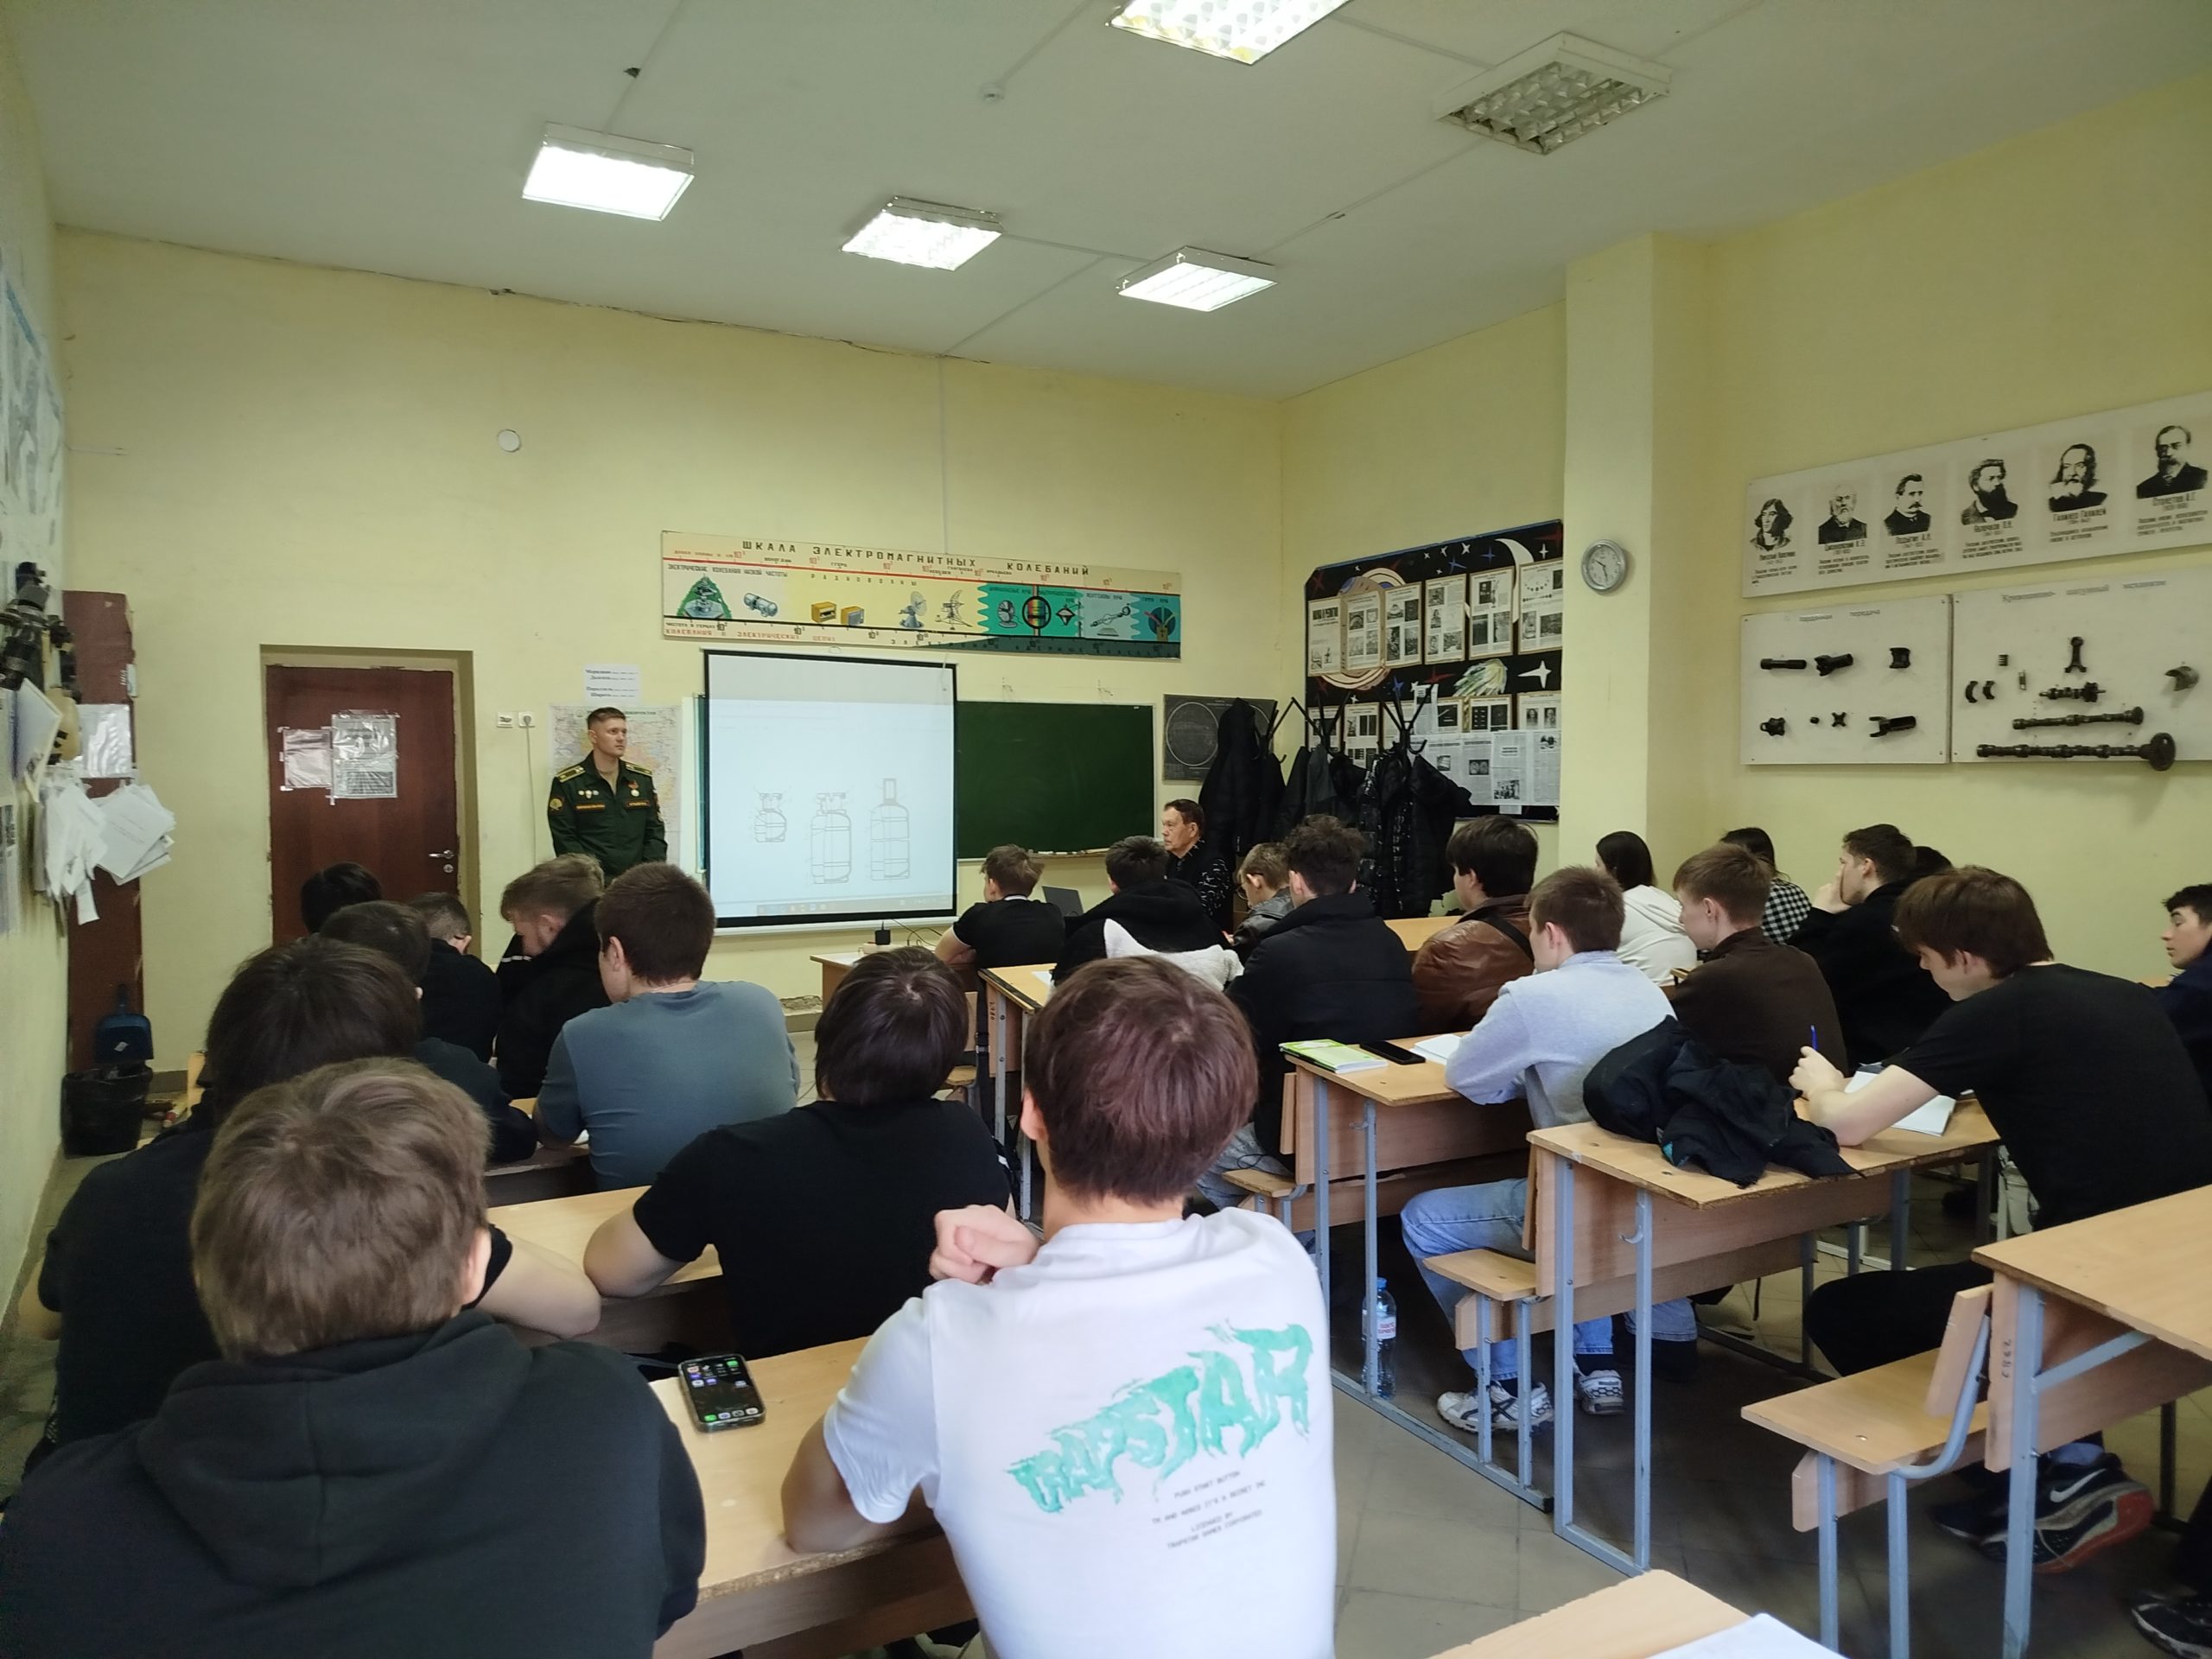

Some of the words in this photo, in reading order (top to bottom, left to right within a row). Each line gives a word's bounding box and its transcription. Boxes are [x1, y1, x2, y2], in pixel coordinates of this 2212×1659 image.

[742, 540, 796, 553] ШКАЛА
[812, 546, 976, 567] ЭЛЕКТРОМАГНИТНЫХ
[1007, 563, 1089, 575] КОЛЕБАНИЙ
